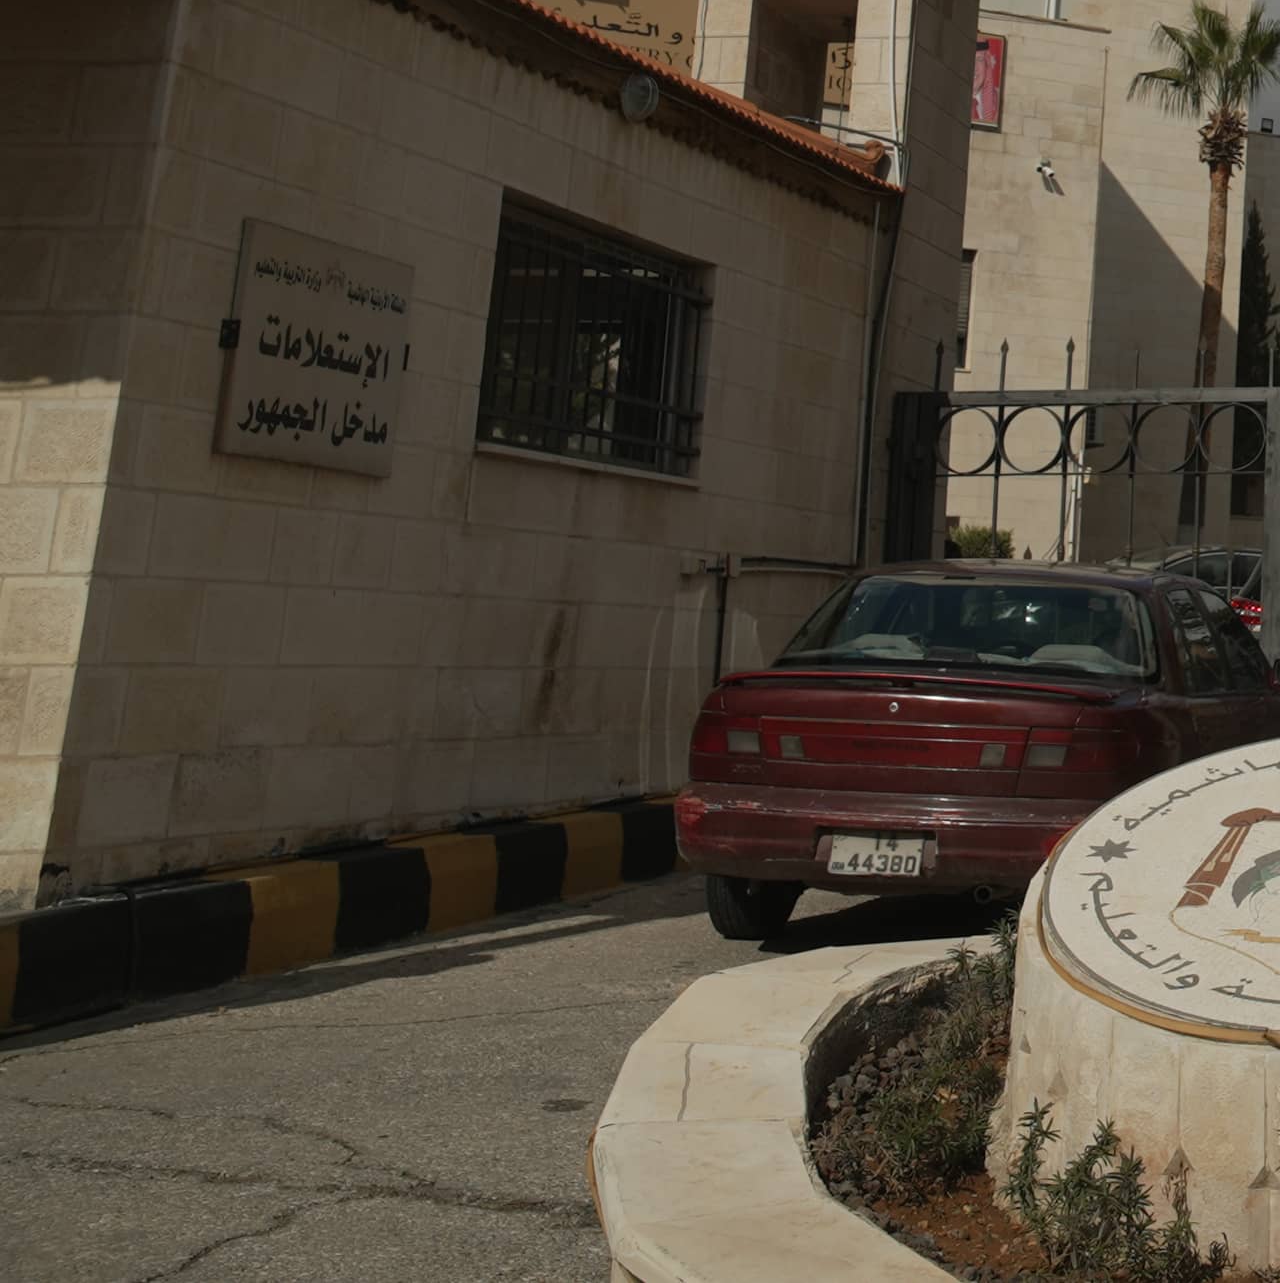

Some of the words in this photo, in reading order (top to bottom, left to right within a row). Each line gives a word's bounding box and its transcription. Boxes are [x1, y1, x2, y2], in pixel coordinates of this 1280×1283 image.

[258, 314, 390, 388] الإستعلامات
[237, 395, 328, 441] الجمهور
[330, 400, 388, 446] مدخل
[847, 853, 917, 873] 44380
